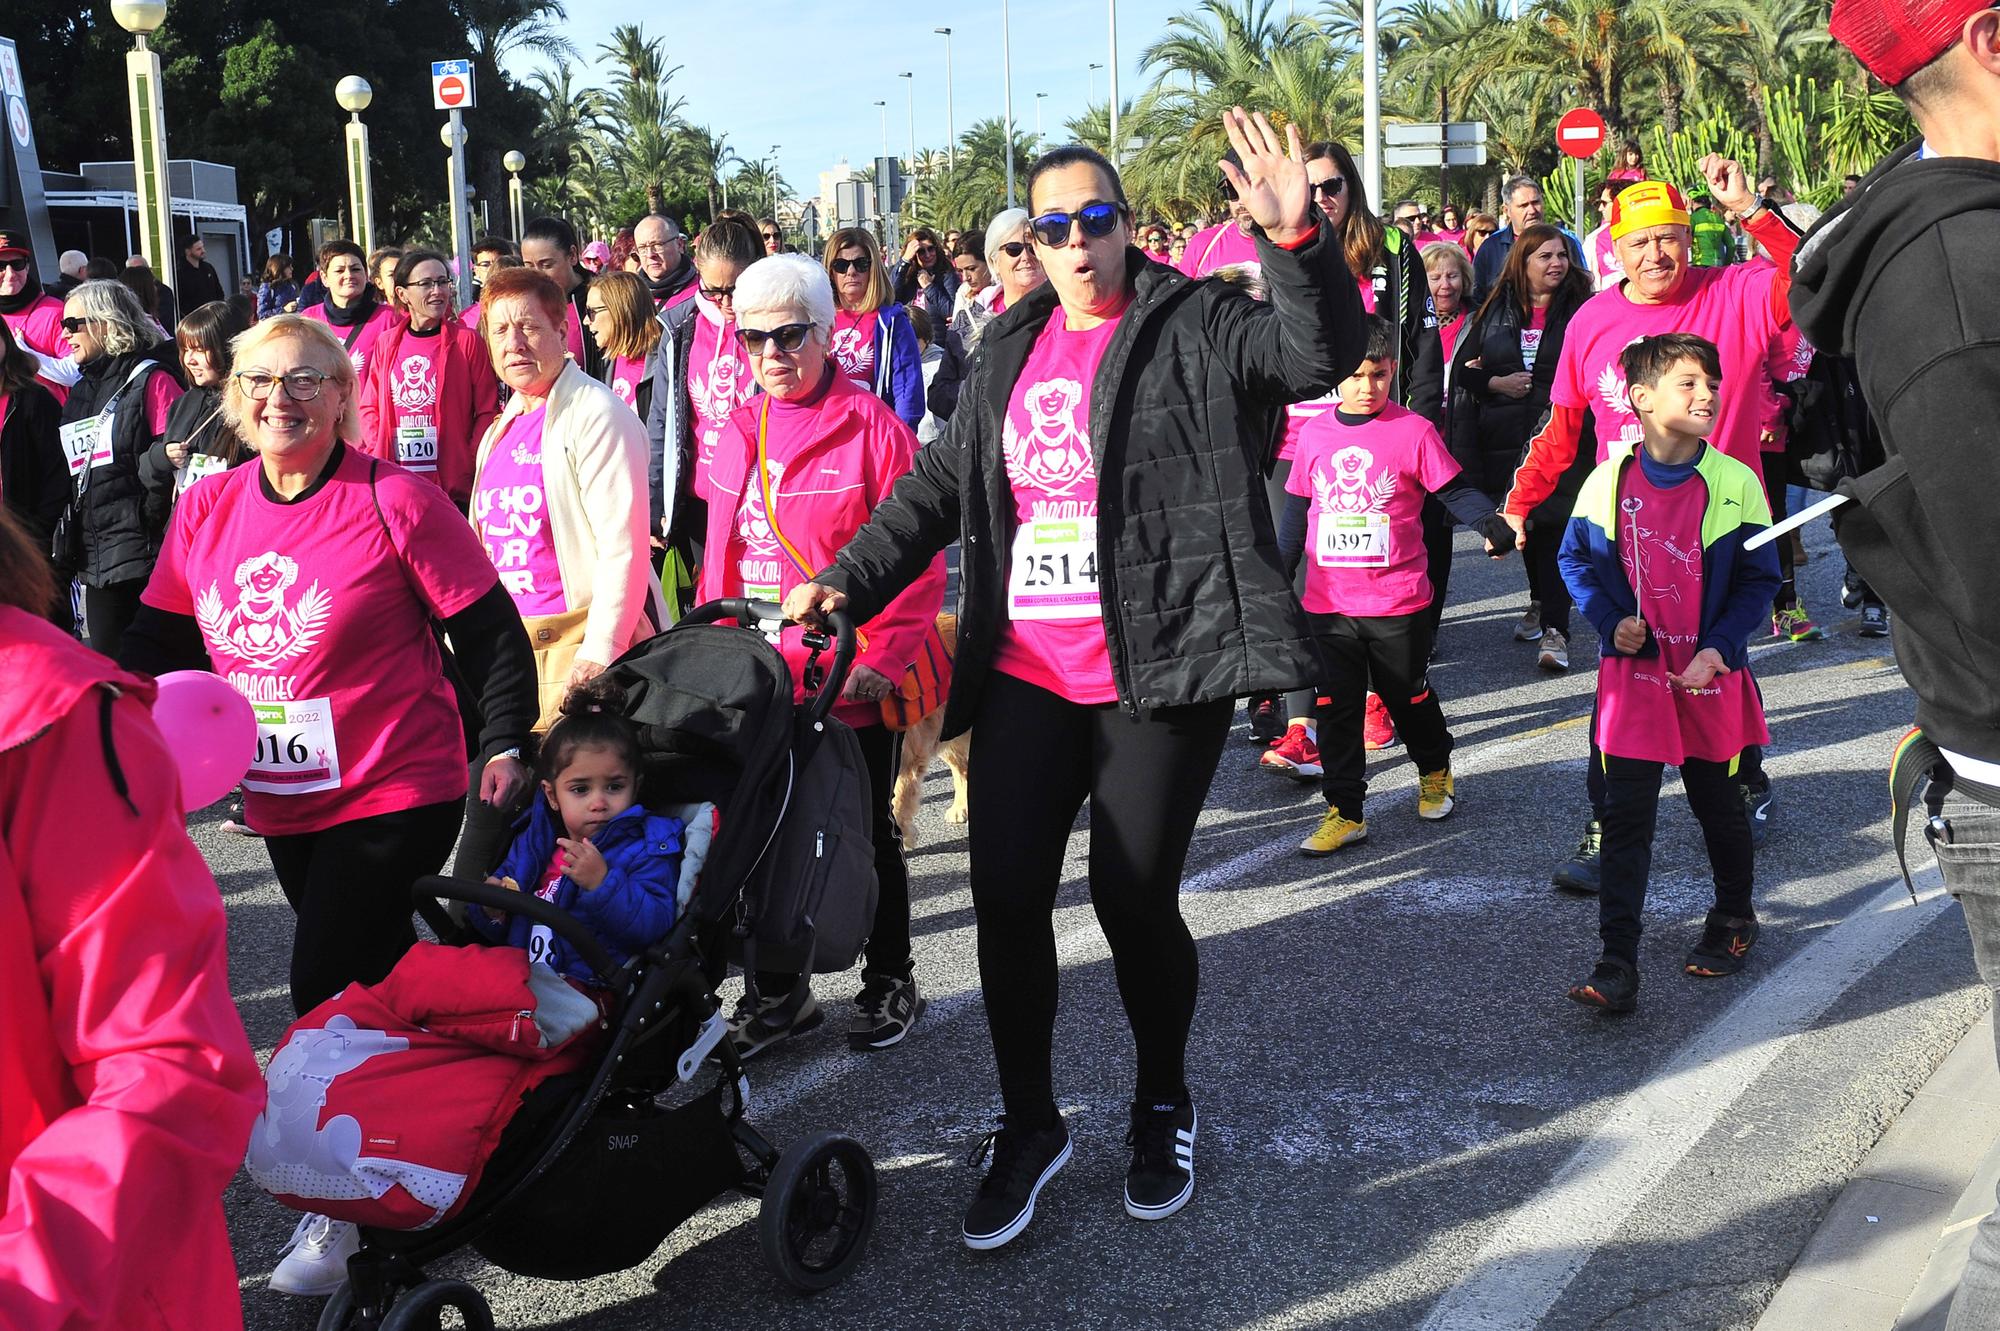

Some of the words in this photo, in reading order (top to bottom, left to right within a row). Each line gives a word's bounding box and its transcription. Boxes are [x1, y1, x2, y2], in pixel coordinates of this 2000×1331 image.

[71, 433, 91, 457] 12
[398, 441, 434, 458] 3120
[1327, 533, 1372, 551] 0397
[1024, 551, 1099, 586] 2514
[288, 711, 321, 724] 2022
[608, 1134, 639, 1150] SNAP
